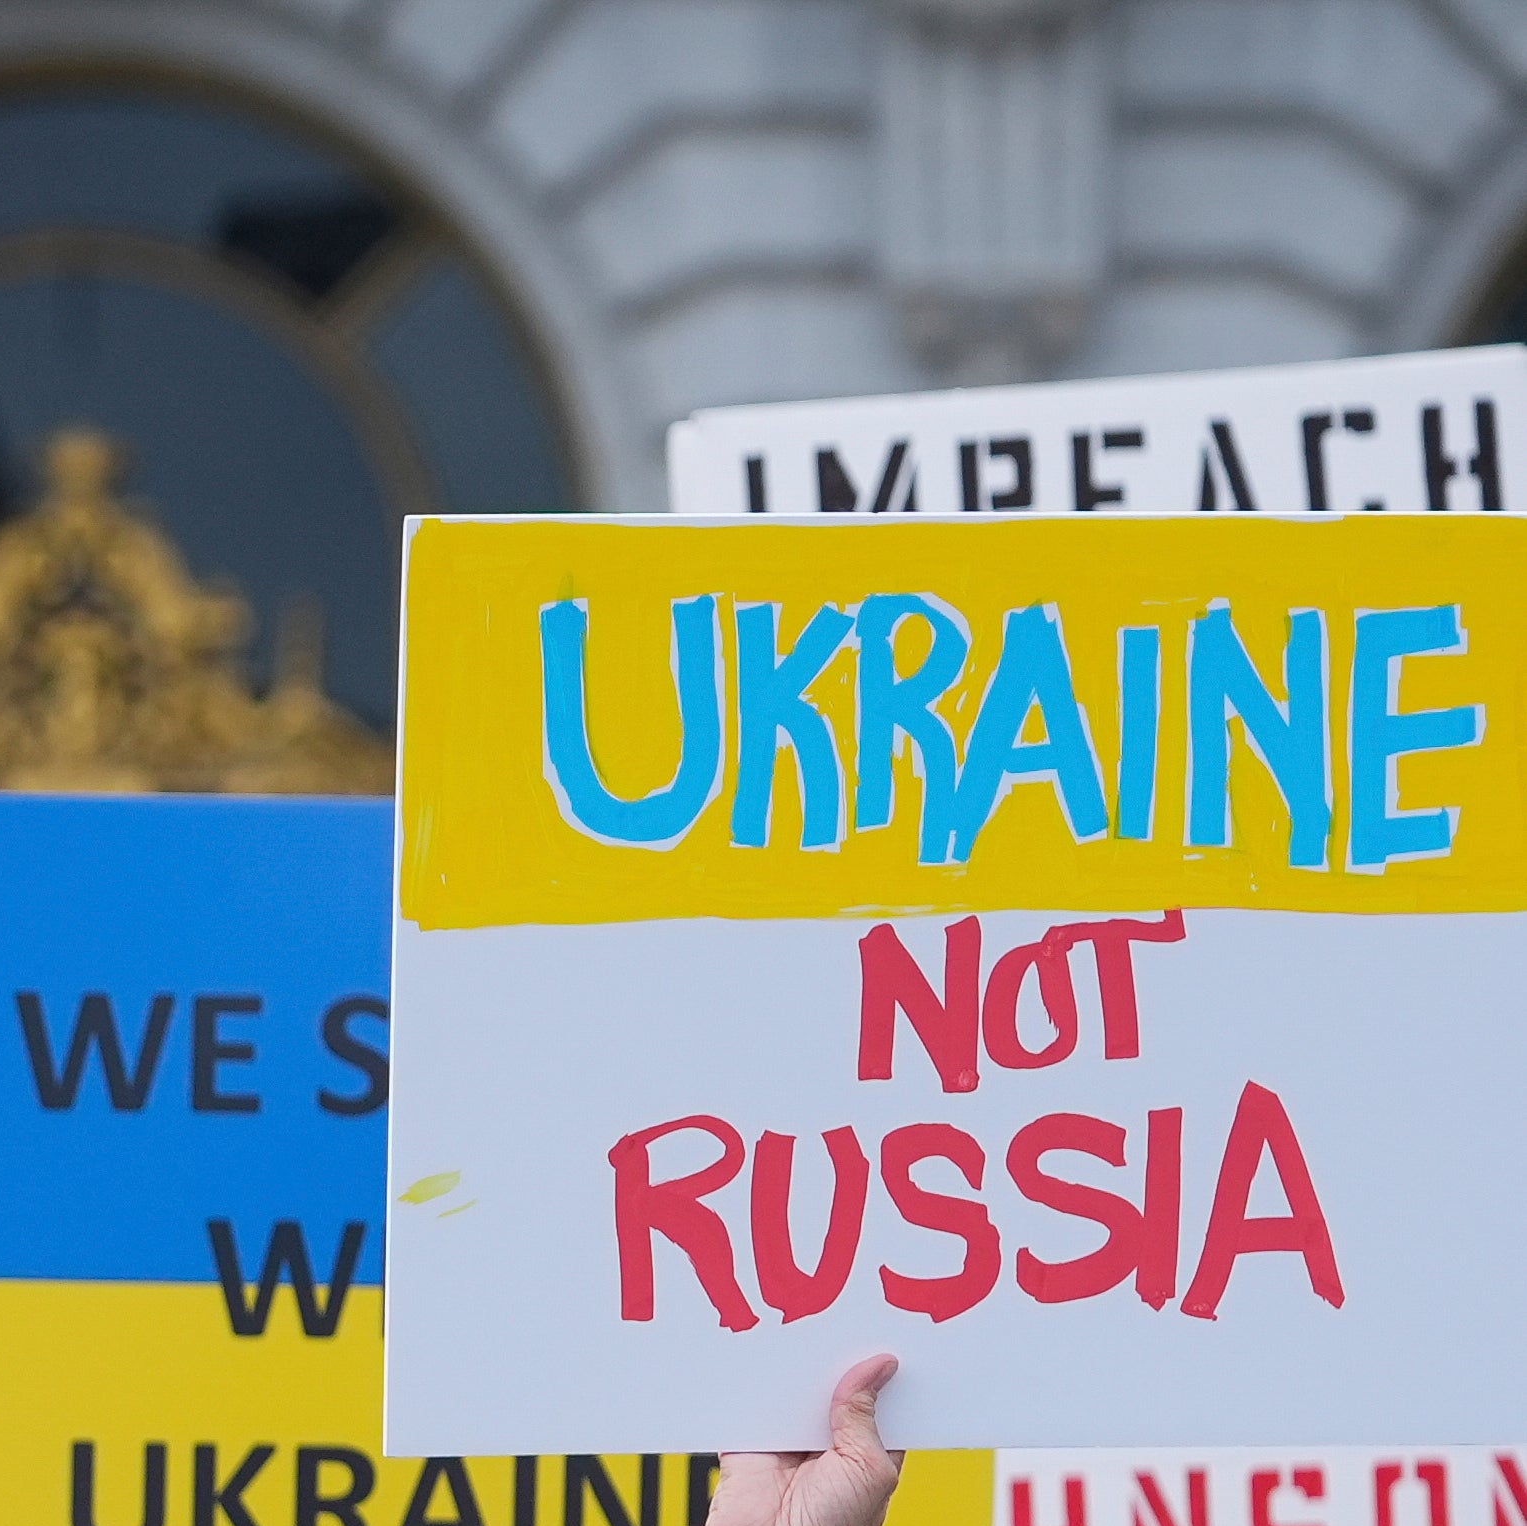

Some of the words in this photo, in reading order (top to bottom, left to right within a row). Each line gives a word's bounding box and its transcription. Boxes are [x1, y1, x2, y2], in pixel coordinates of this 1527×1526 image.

[539, 593, 1487, 876] UKRAINE
[15, 990, 263, 1115] WE
[857, 907, 1188, 1094] NOT
[607, 1080, 1346, 1333] RUSSIA
